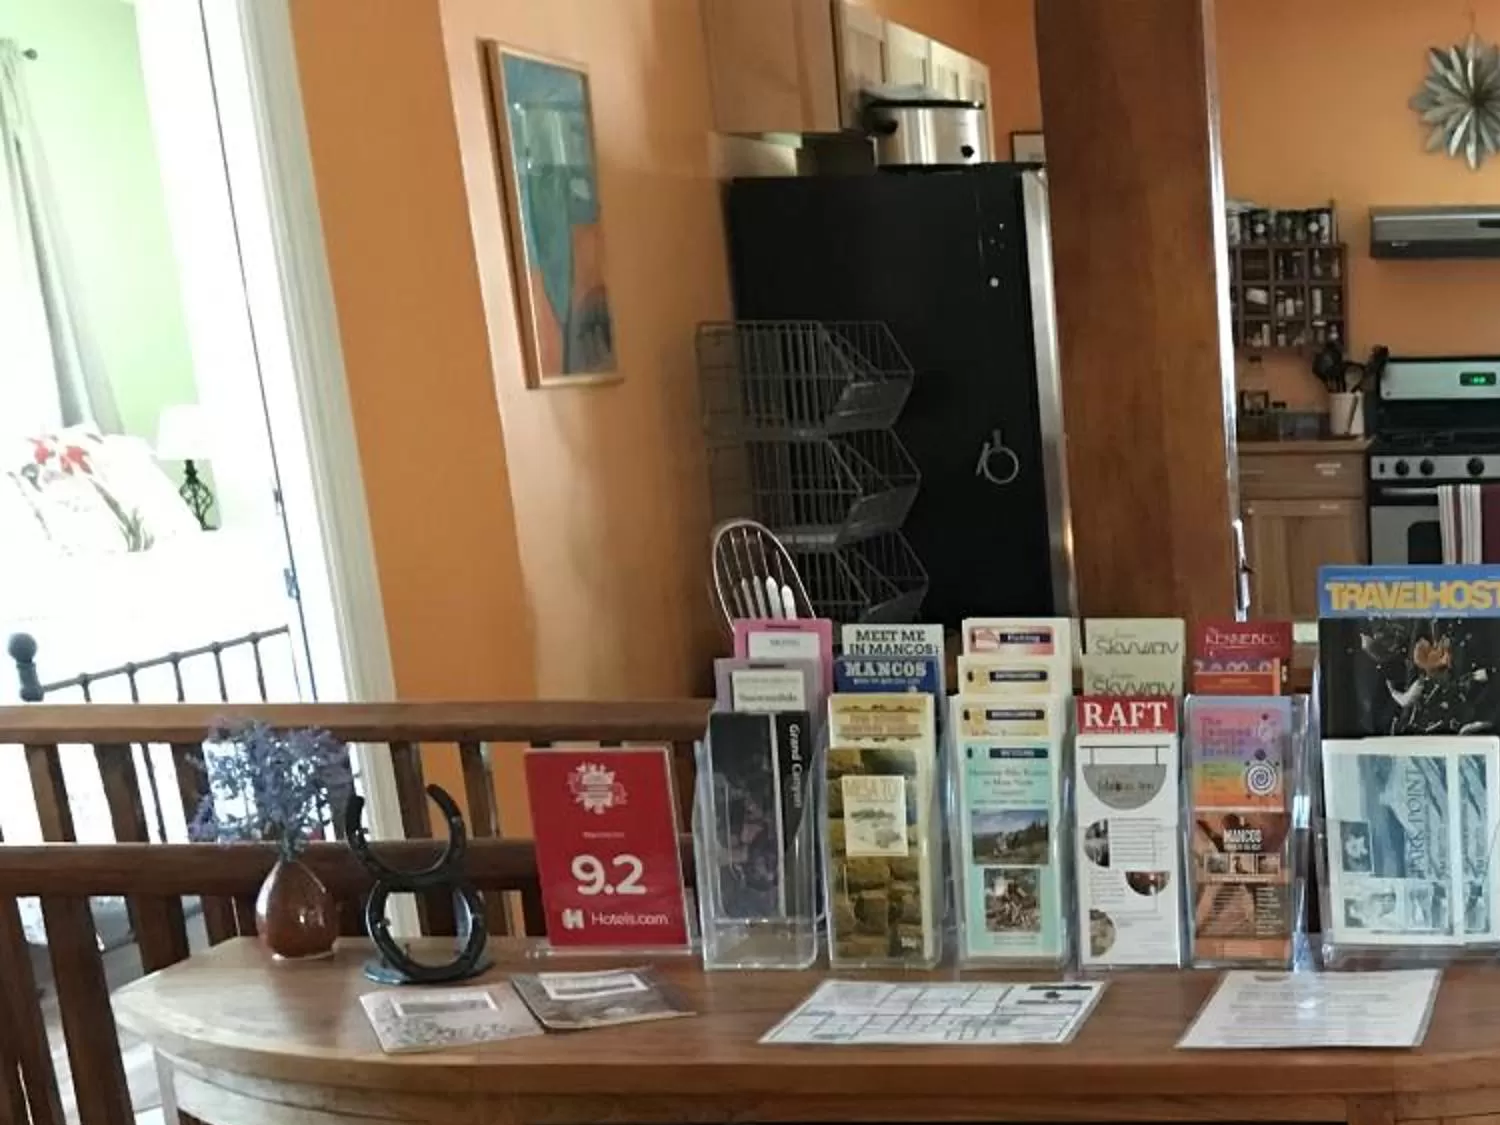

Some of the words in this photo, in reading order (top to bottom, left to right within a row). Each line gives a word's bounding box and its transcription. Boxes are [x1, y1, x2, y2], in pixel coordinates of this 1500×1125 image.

[848, 644, 864, 657] IN
[856, 630, 897, 642] MEET
[901, 629, 925, 641] ME
[844, 661, 927, 677] MANCOS
[1083, 701, 1169, 728] RAFT
[789, 723, 804, 761] Grand
[790, 763, 804, 809] Canyon
[1405, 766, 1427, 824] POINT
[1405, 829, 1427, 880] PARK
[571, 854, 648, 895] 9.2
[591, 911, 669, 926] Hotels.com
